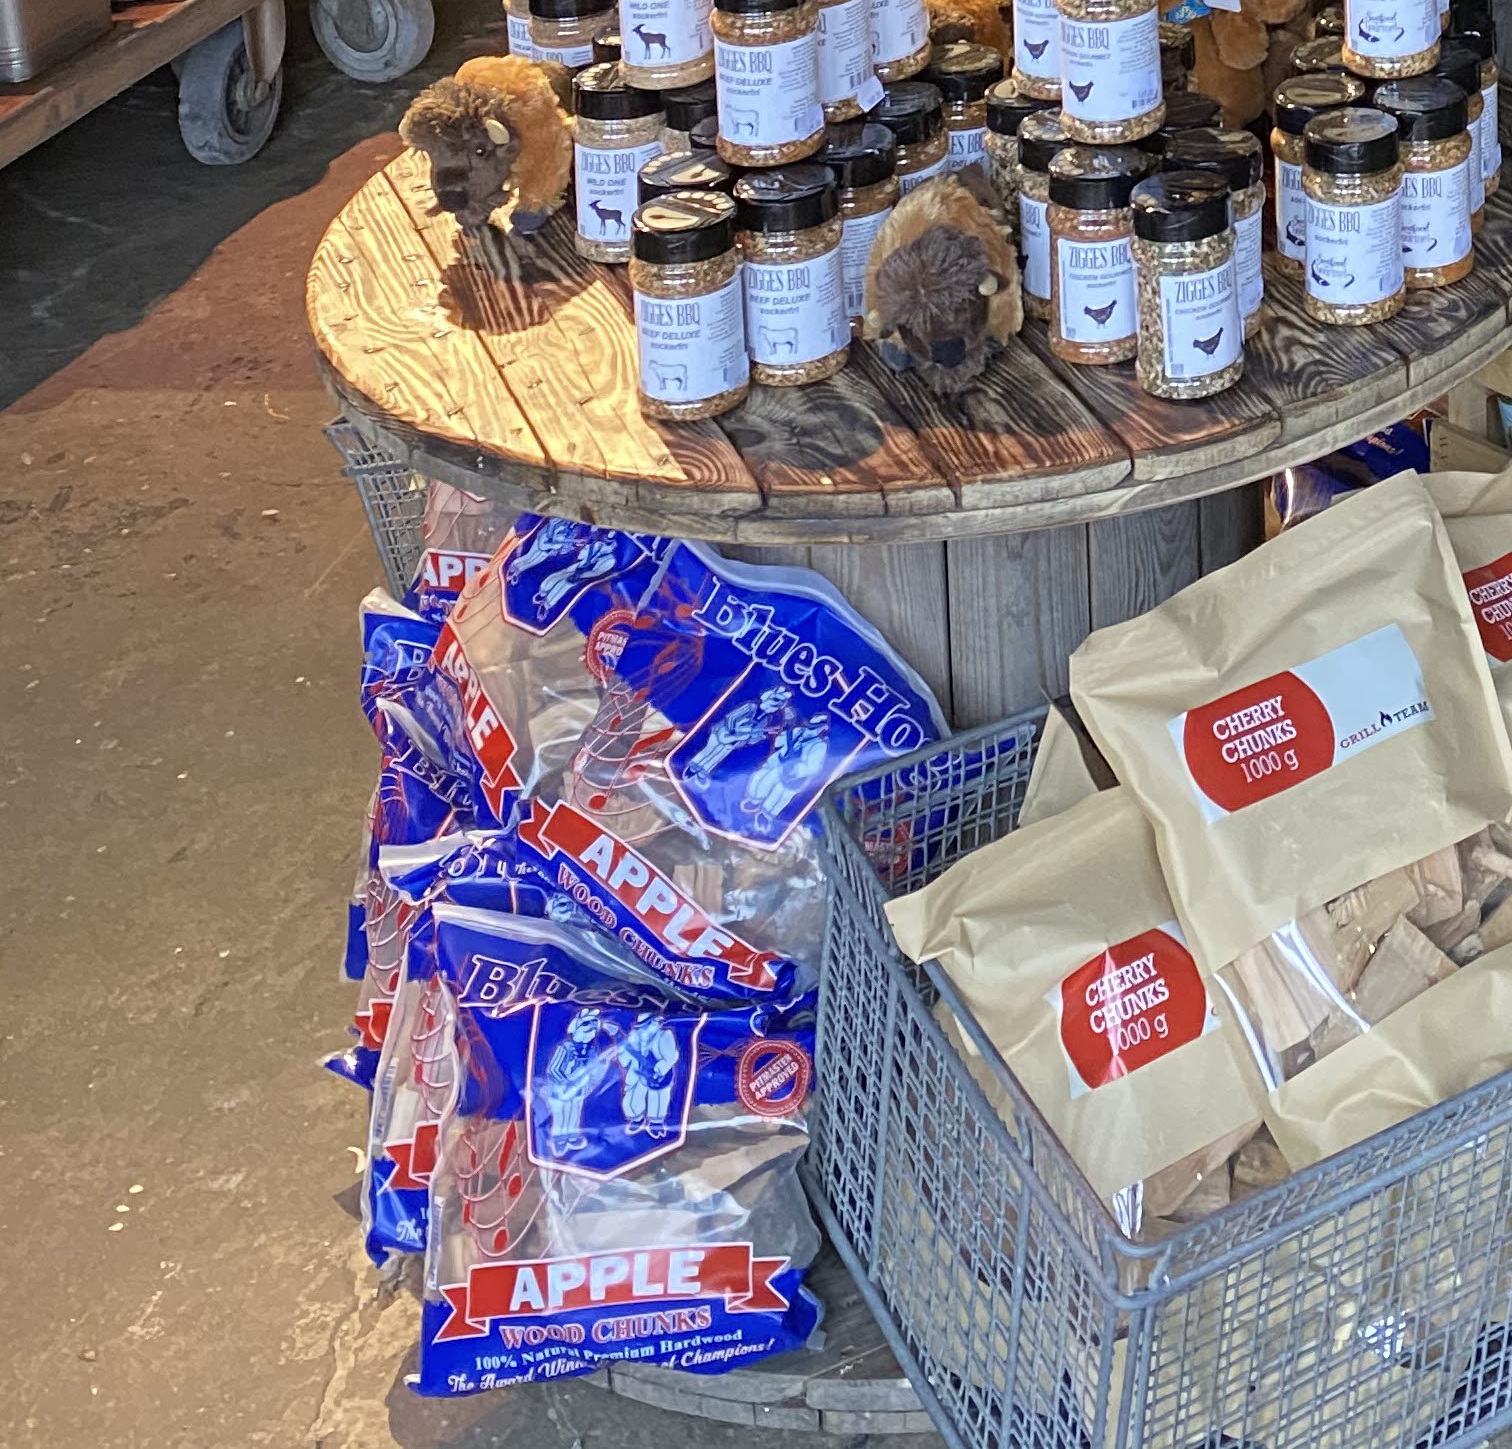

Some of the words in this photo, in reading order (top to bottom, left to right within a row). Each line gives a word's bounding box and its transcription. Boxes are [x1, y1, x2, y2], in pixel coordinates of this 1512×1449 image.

[1087, 27, 1110, 50] BBQ
[750, 51, 773, 74] BBQ
[614, 152, 636, 175] BBQ
[1421, 175, 1442, 199] BBQ
[1339, 210, 1361, 234] BBQ
[1069, 245, 1108, 270] ZIGGES
[788, 266, 811, 291] BBQ
[1174, 275, 1216, 304] ZIGGES
[677, 302, 701, 328] BBQ
[692, 575, 844, 698] Blues
[1212, 695, 1287, 741] CHERRY
[1339, 723, 1382, 750] GRILL
[1393, 700, 1430, 723] TEAM
[1222, 718, 1298, 764] CHUNKS
[1239, 751, 1282, 784] 1000
[1284, 749, 1300, 771] g
[578, 834, 735, 964] APPLE
[557, 861, 619, 931] WOOD
[619, 926, 717, 988] CHUNKS
[1085, 952, 1158, 1007] CHERRY
[1089, 977, 1170, 1034] CHUNKS
[1154, 1013, 1169, 1039] g
[749, 1053, 793, 1093] PITMASTER
[754, 1061, 800, 1101] APPROVED
[509, 1249, 705, 1313] APPLE
[499, 1322, 584, 1350] WOOD
[591, 1306, 712, 1344] CHUNKS
[448, 1373, 475, 1393] The
[479, 1370, 534, 1392] Award
[680, 1338, 776, 1367] Champions!
[475, 1353, 518, 1371] 100%
[521, 1346, 580, 1367] Natural
[659, 1329, 743, 1355] Hardwood
